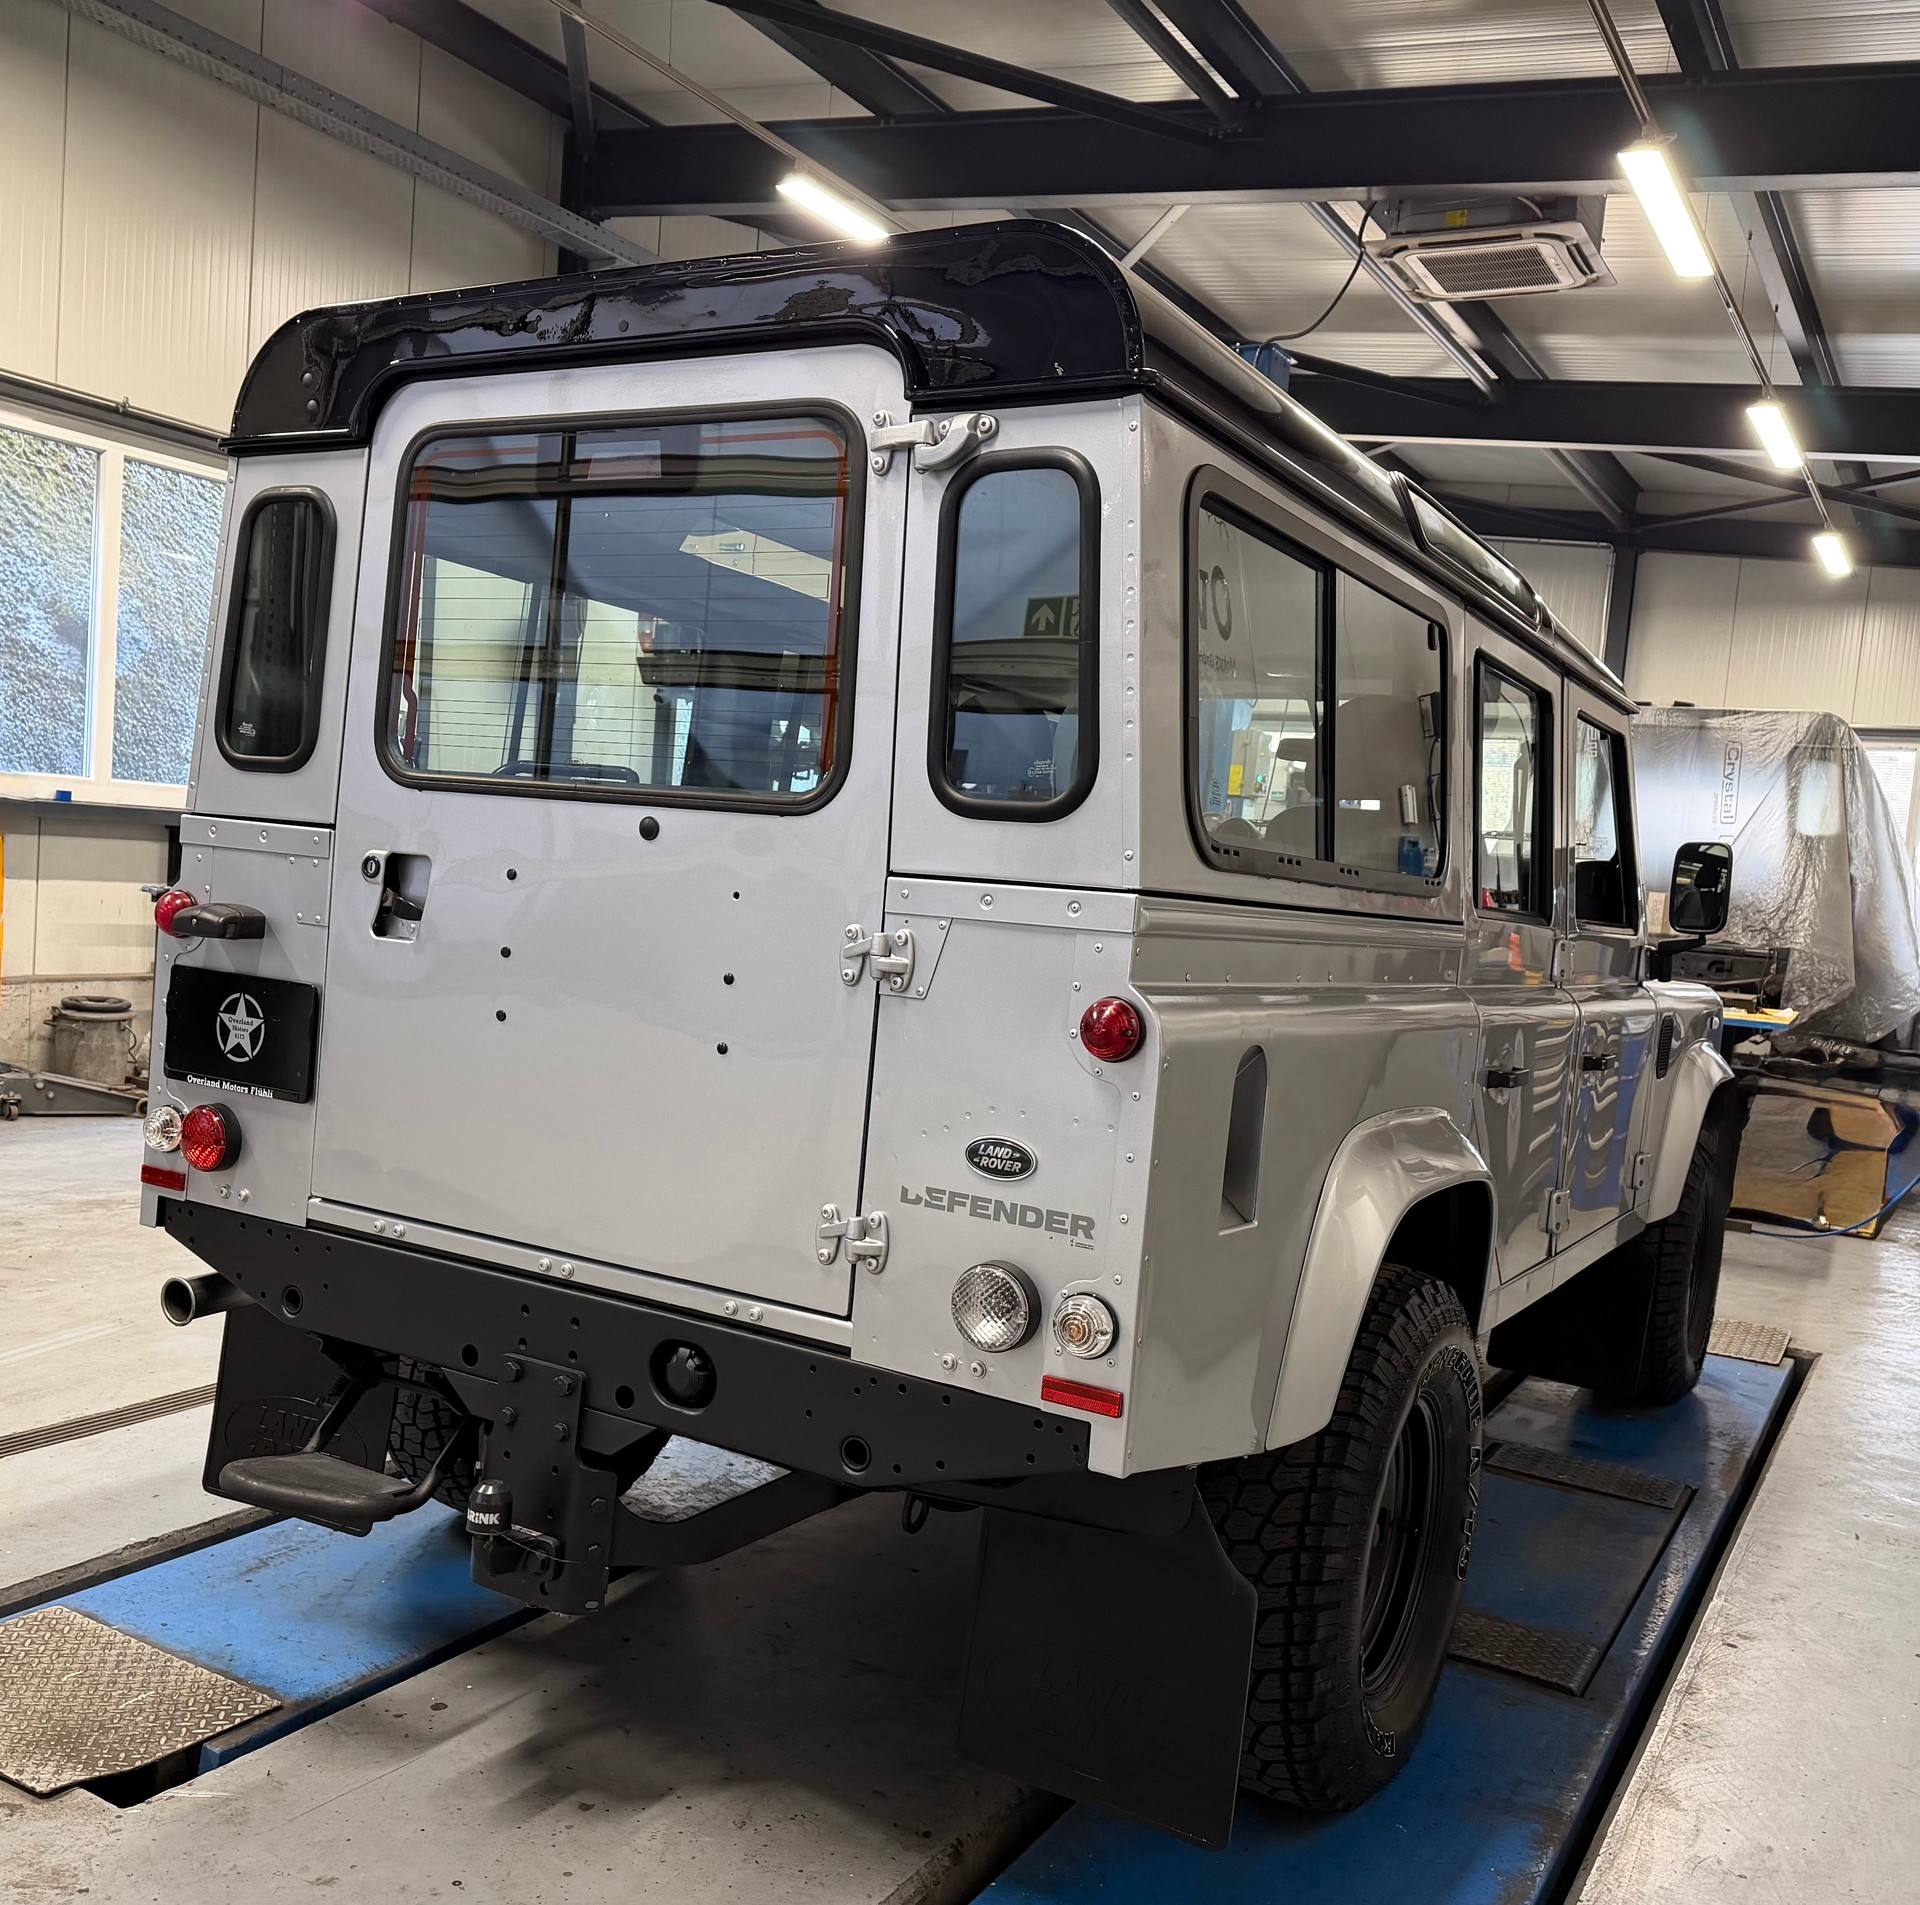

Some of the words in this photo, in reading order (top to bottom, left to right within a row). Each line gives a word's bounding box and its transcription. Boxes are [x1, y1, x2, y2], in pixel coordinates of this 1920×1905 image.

[1723, 747, 1740, 819] Crystal
[228, 1016, 253, 1026] Overland
[232, 1025, 248, 1033] Motors
[187, 1074, 220, 1089] Overland
[222, 1082, 248, 1094] Motors
[250, 1086, 273, 1098] Flühli
[977, 1143, 1013, 1159] LAND
[979, 1156, 1022, 1173] ROVER
[900, 1185, 1096, 1240] DEFENDER
